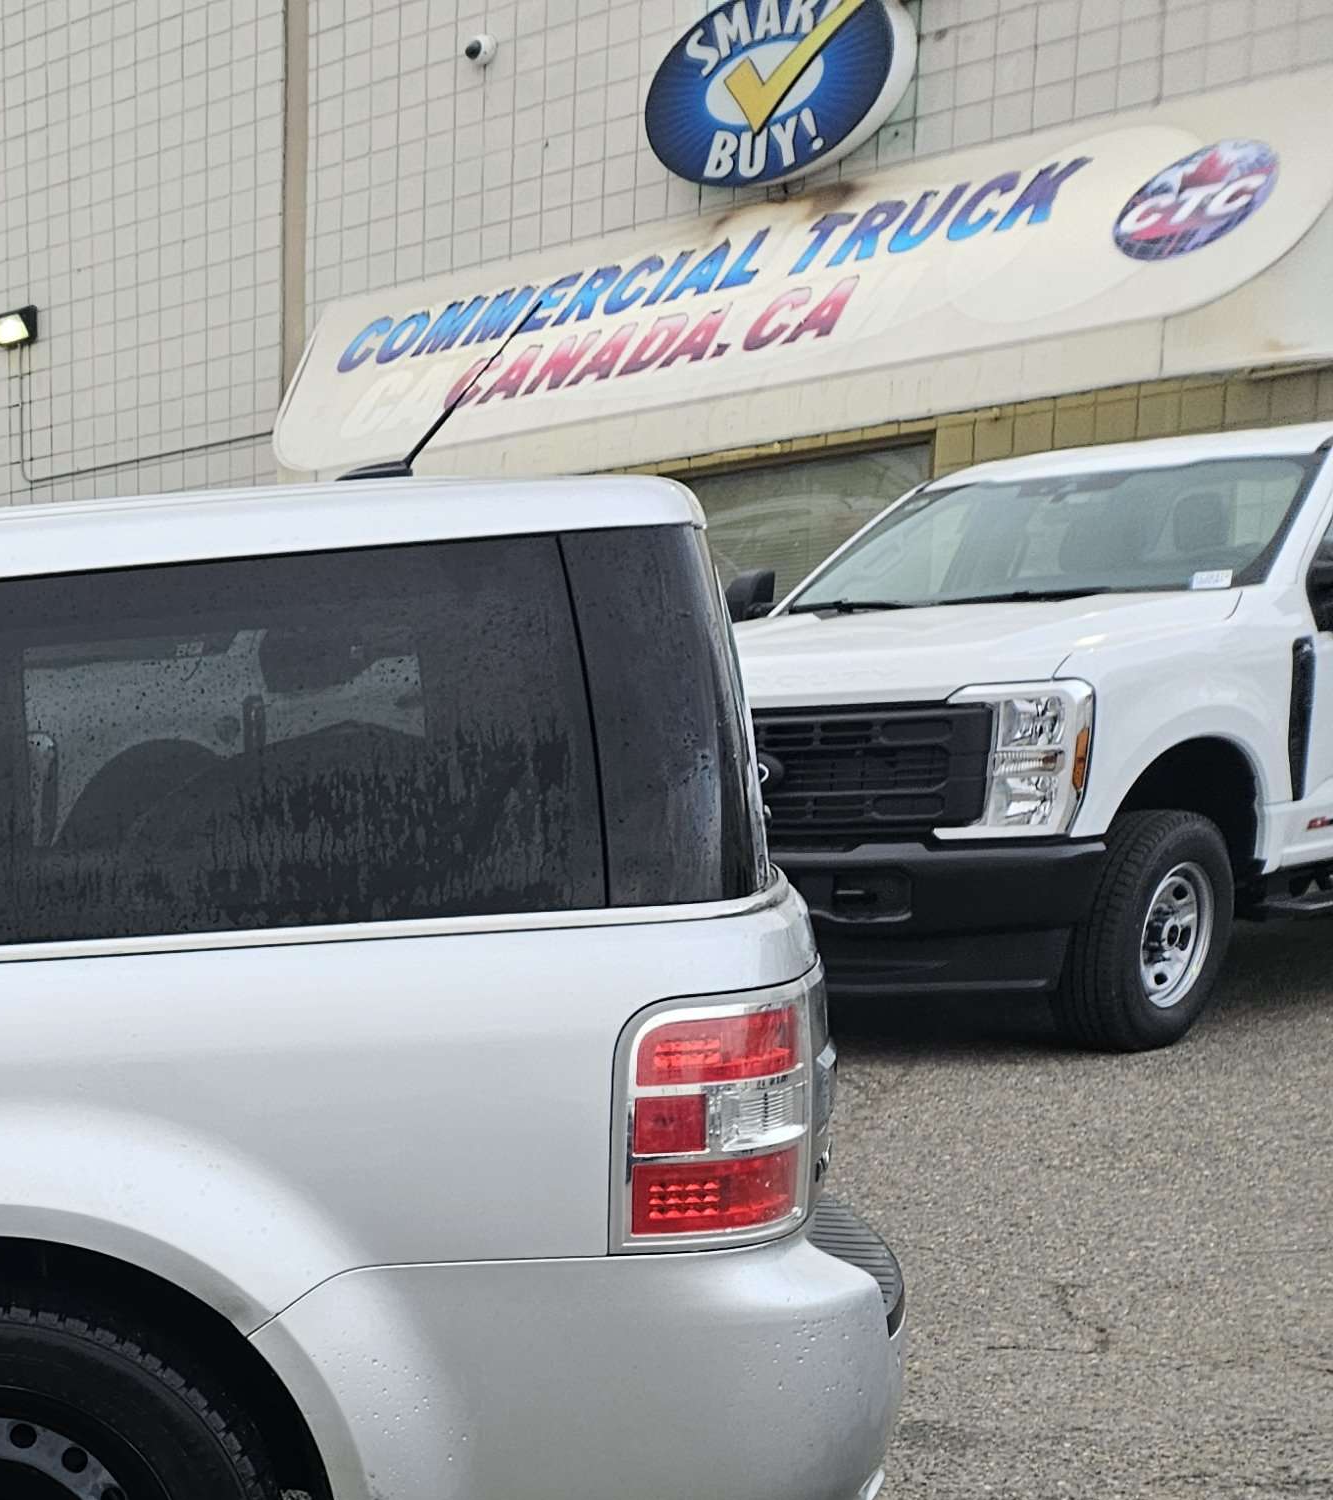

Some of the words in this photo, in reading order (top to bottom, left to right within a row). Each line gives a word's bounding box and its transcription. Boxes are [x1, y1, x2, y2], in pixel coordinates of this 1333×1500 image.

[685, 0, 841, 77] SMAR
[703, 107, 824, 178] BUY!
[1120, 173, 1267, 236] CTC
[336, 226, 771, 374] COMMERCIAL
[788, 156, 1093, 277] TRUCK
